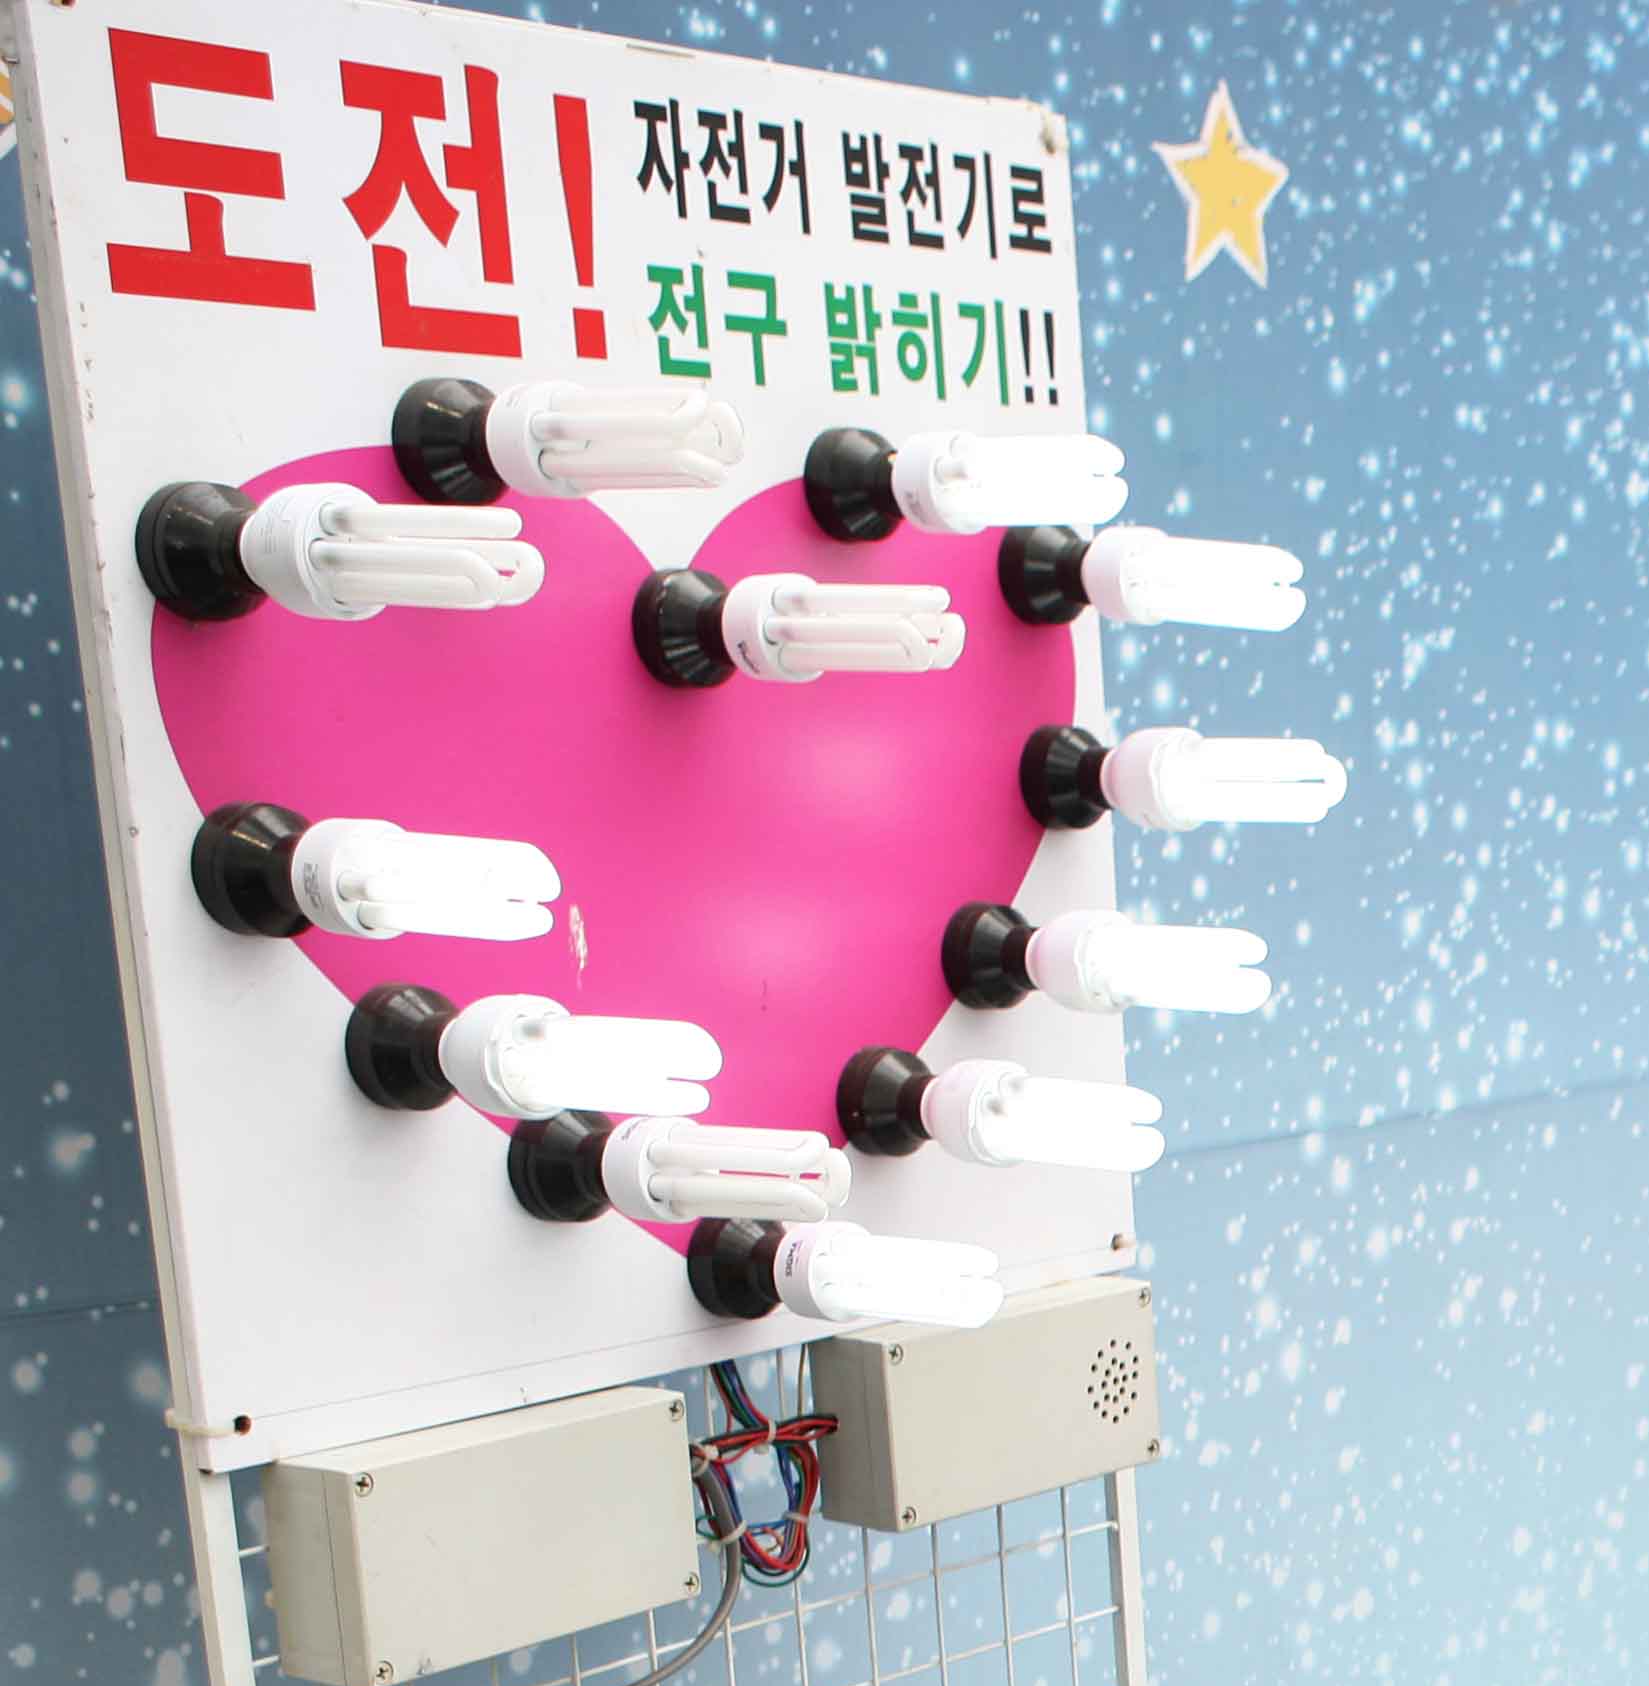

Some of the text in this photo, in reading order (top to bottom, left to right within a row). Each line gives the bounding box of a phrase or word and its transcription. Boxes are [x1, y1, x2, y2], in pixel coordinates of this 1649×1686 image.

[107, 26, 608, 361] 도전!
[633, 97, 1055, 260] 자전거 발전기로
[645, 262, 1061, 407] 전구 밝히기!!
